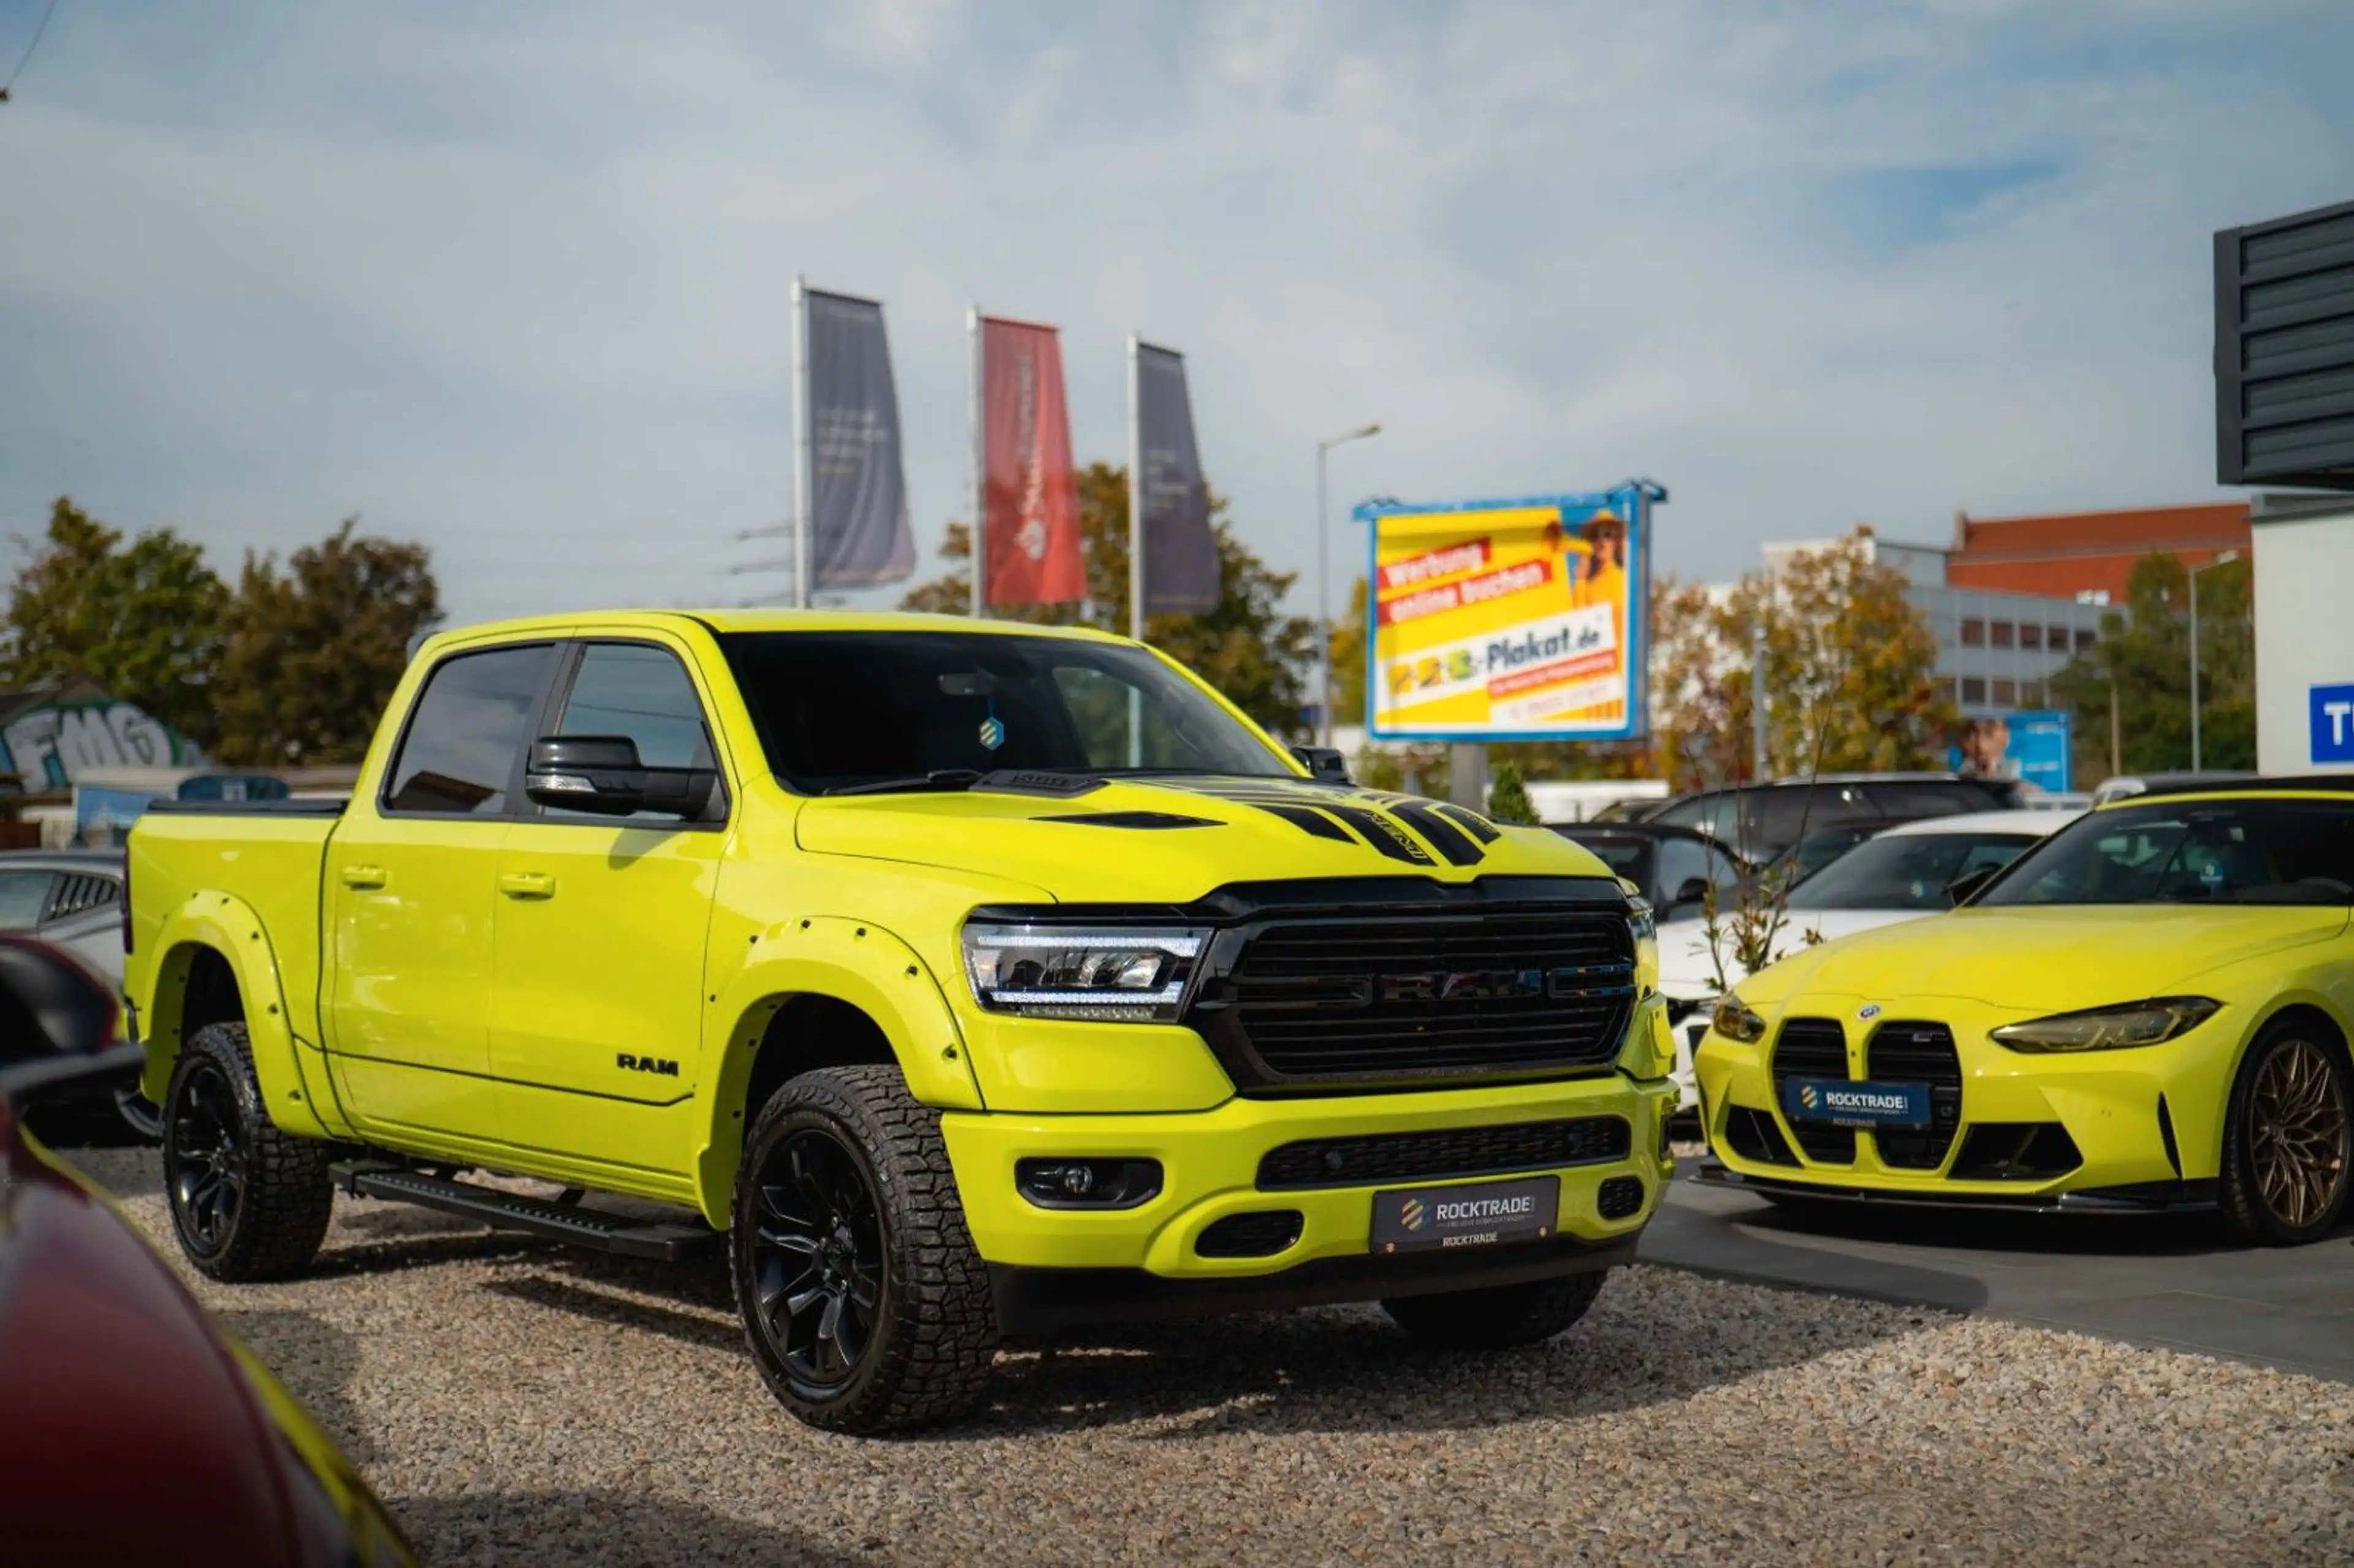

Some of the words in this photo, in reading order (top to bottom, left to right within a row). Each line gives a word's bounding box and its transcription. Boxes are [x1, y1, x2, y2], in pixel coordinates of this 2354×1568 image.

[1385, 542, 1484, 588] Werbung
[1460, 560, 1544, 603] buchen
[2323, 701, 2354, 746] T
[615, 1052, 679, 1078] RAM
[1826, 1091, 1903, 1109] ROCKTRADE
[1436, 1196, 1531, 1220] ROCKTRADE
[1442, 1231, 1498, 1247] ROCKTRADE
